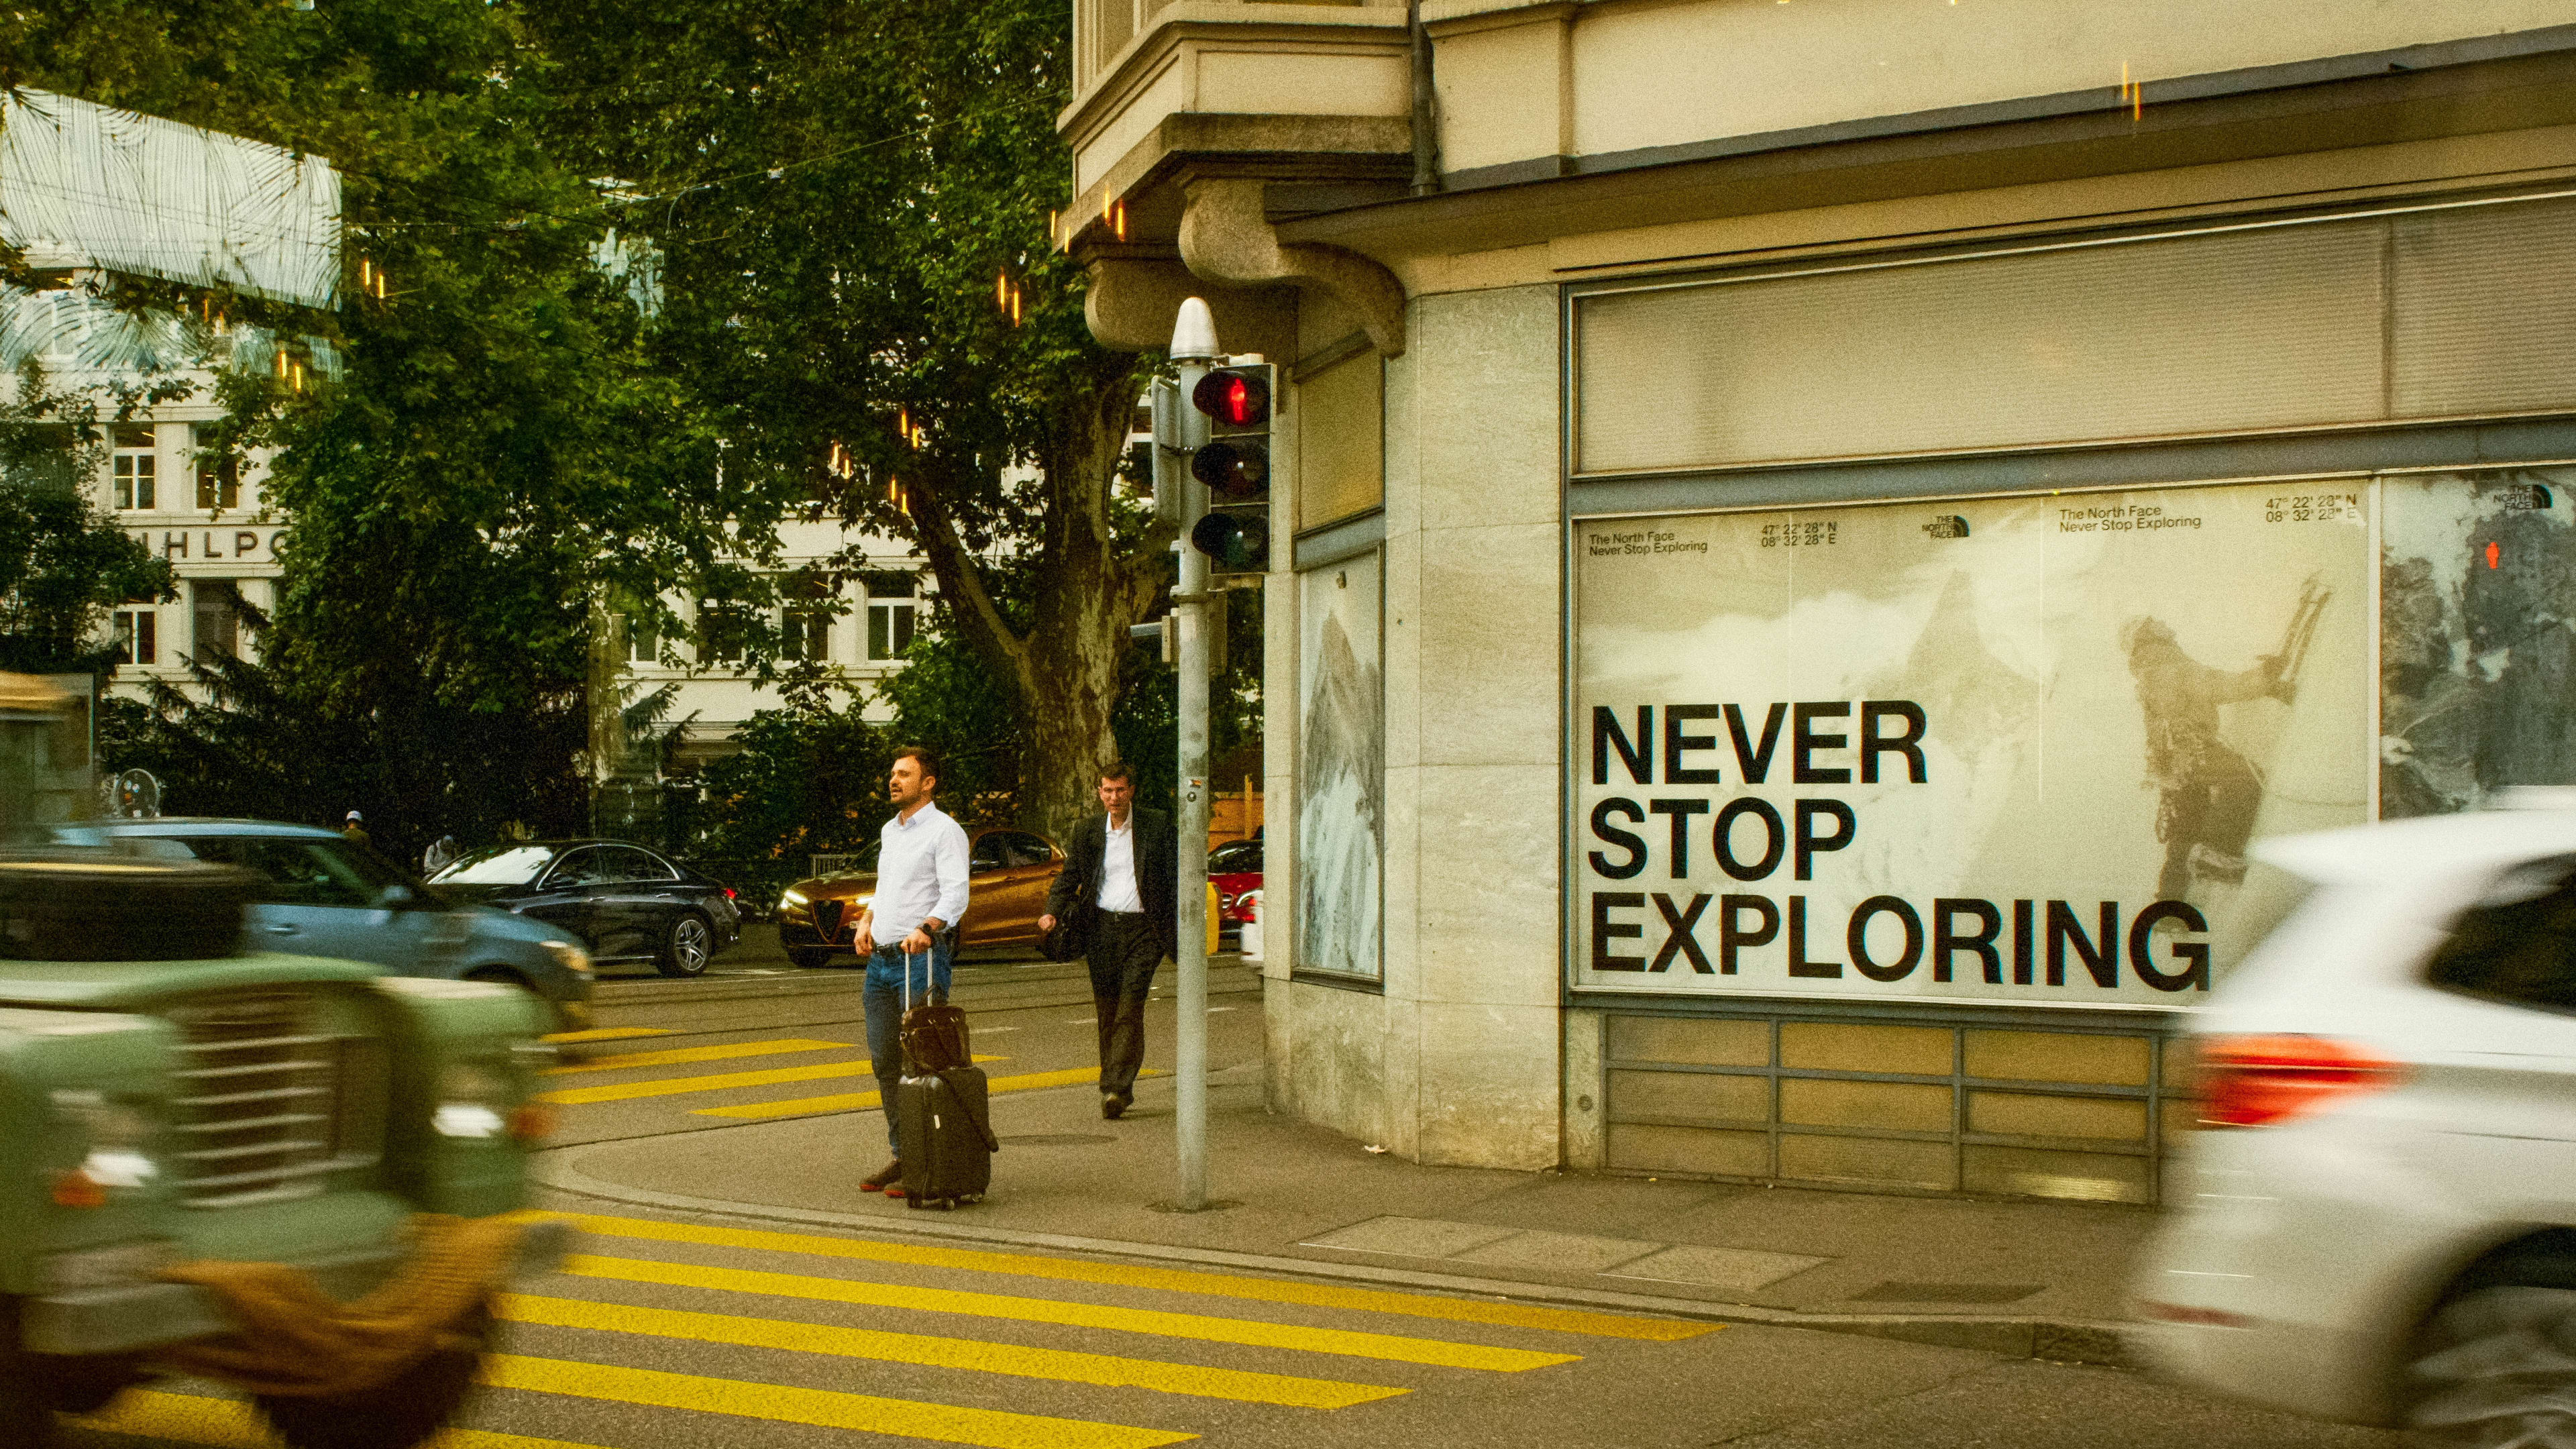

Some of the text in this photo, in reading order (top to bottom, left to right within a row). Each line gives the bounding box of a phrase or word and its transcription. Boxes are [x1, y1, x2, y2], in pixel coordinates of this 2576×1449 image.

[2510, 485, 2531, 493] THE
[2346, 494, 2356, 505] N
[2493, 494, 2532, 502] NORTH
[2505, 502, 2532, 510] FACE
[2059, 506, 2161, 520] The North Face
[2347, 507, 2356, 519] E
[1827, 521, 1837, 532] N
[2059, 516, 2201, 533] Never Stop Exploring
[1589, 531, 1674, 545] The North Face
[1828, 533, 1836, 544] E
[1589, 540, 1708, 556] Never Stop Exploring
[1592, 700, 1927, 785] NEVER
[1588, 796, 1857, 881] STOP
[1591, 892, 2211, 992] EXPLORING
